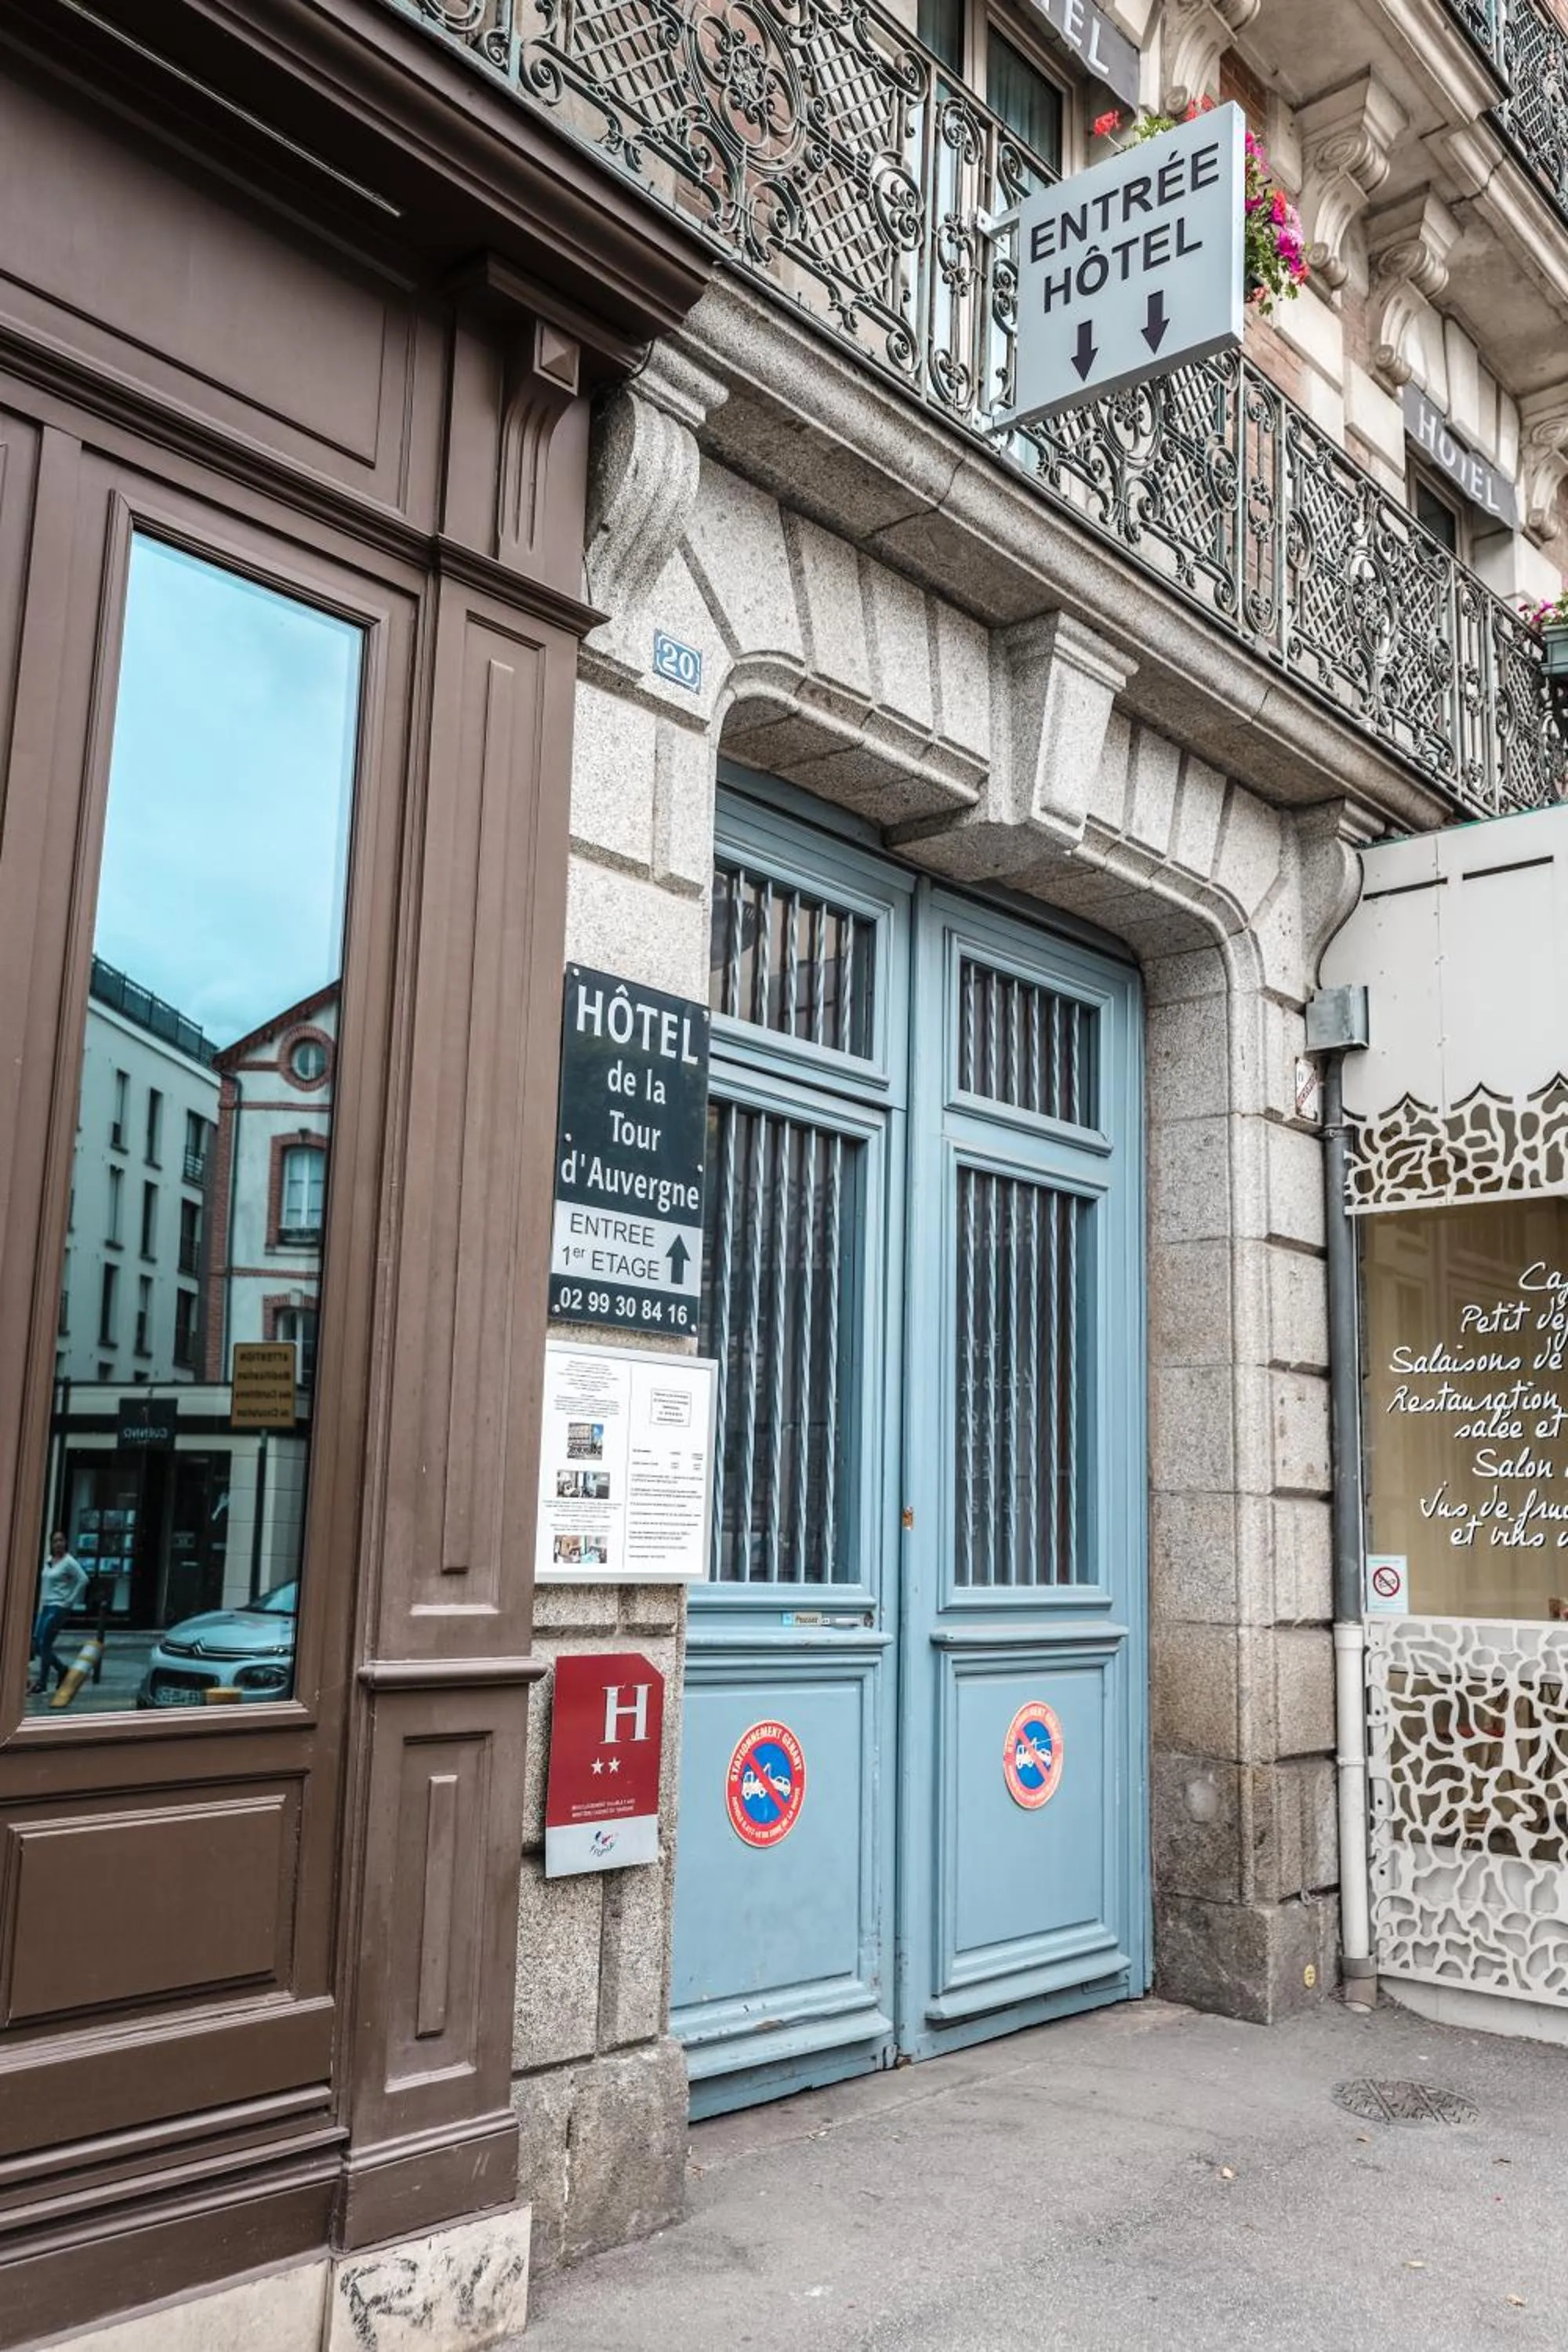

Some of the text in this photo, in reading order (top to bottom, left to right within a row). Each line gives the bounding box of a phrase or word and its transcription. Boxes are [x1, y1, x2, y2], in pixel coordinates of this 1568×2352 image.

[1030, 142, 1220, 263] ENTRÉE
[1044, 216, 1203, 314] HÔTEL
[662, 643, 695, 680] 20
[575, 984, 699, 1065] HÔTEL
[608, 1059, 666, 1105] de la
[609, 1109, 662, 1152] Tour
[561, 1149, 700, 1213] d'Auvergne
[570, 1212, 655, 1247] ENTREE
[562, 1245, 660, 1280] 1er ETAGE
[560, 1287, 688, 1325] 02 99 30 84 16
[1461, 1299, 1531, 1333] Petit
[1388, 1336, 1563, 1373] Salaisons de
[1387, 1379, 1559, 1412] Restauration
[1454, 1406, 1568, 1439] salée et
[1472, 1446, 1554, 1479] Salon
[1479, 1484, 1509, 1518] de
[1450, 1514, 1484, 1545] et
[1490, 1516, 1545, 1548] vins
[598, 1683, 652, 1744] H
